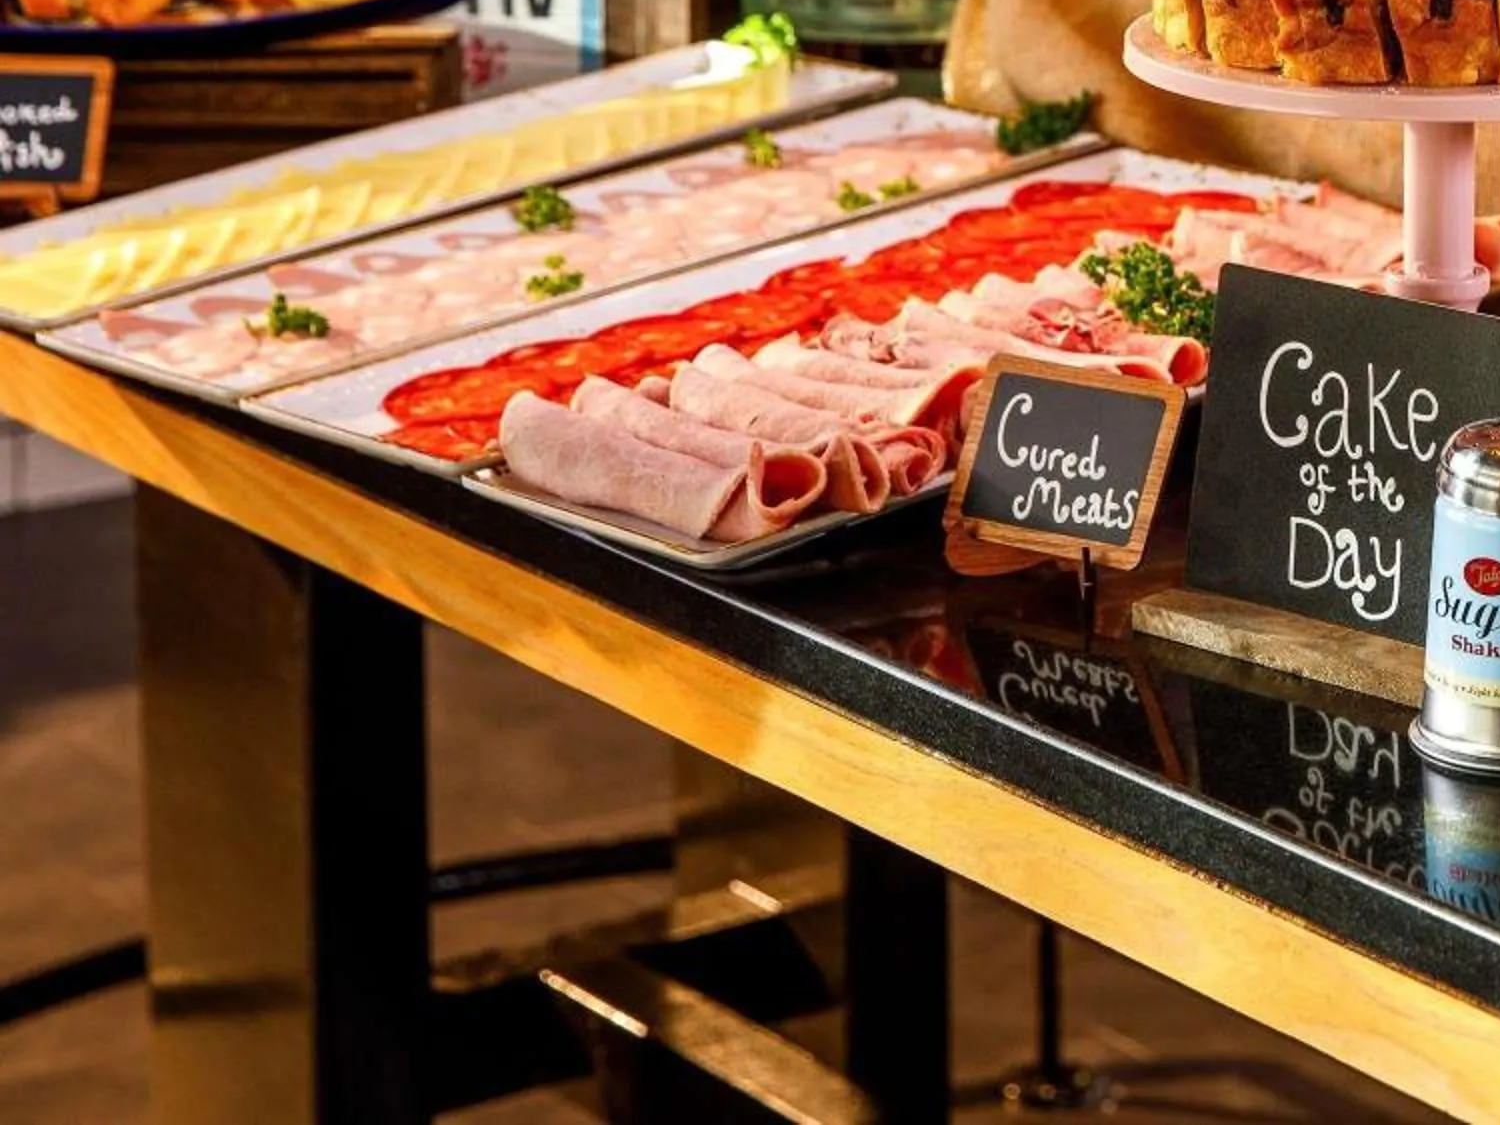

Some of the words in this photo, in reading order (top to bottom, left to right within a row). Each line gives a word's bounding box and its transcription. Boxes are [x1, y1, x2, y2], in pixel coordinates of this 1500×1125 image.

[0, 94, 78, 125] oked
[997, 392, 1106, 480] Cured
[1259, 341, 1439, 462] Cake
[1012, 477, 1139, 530] Meats
[1299, 461, 1336, 515] of
[1348, 460, 1404, 512] the
[1288, 516, 1401, 621] Day
